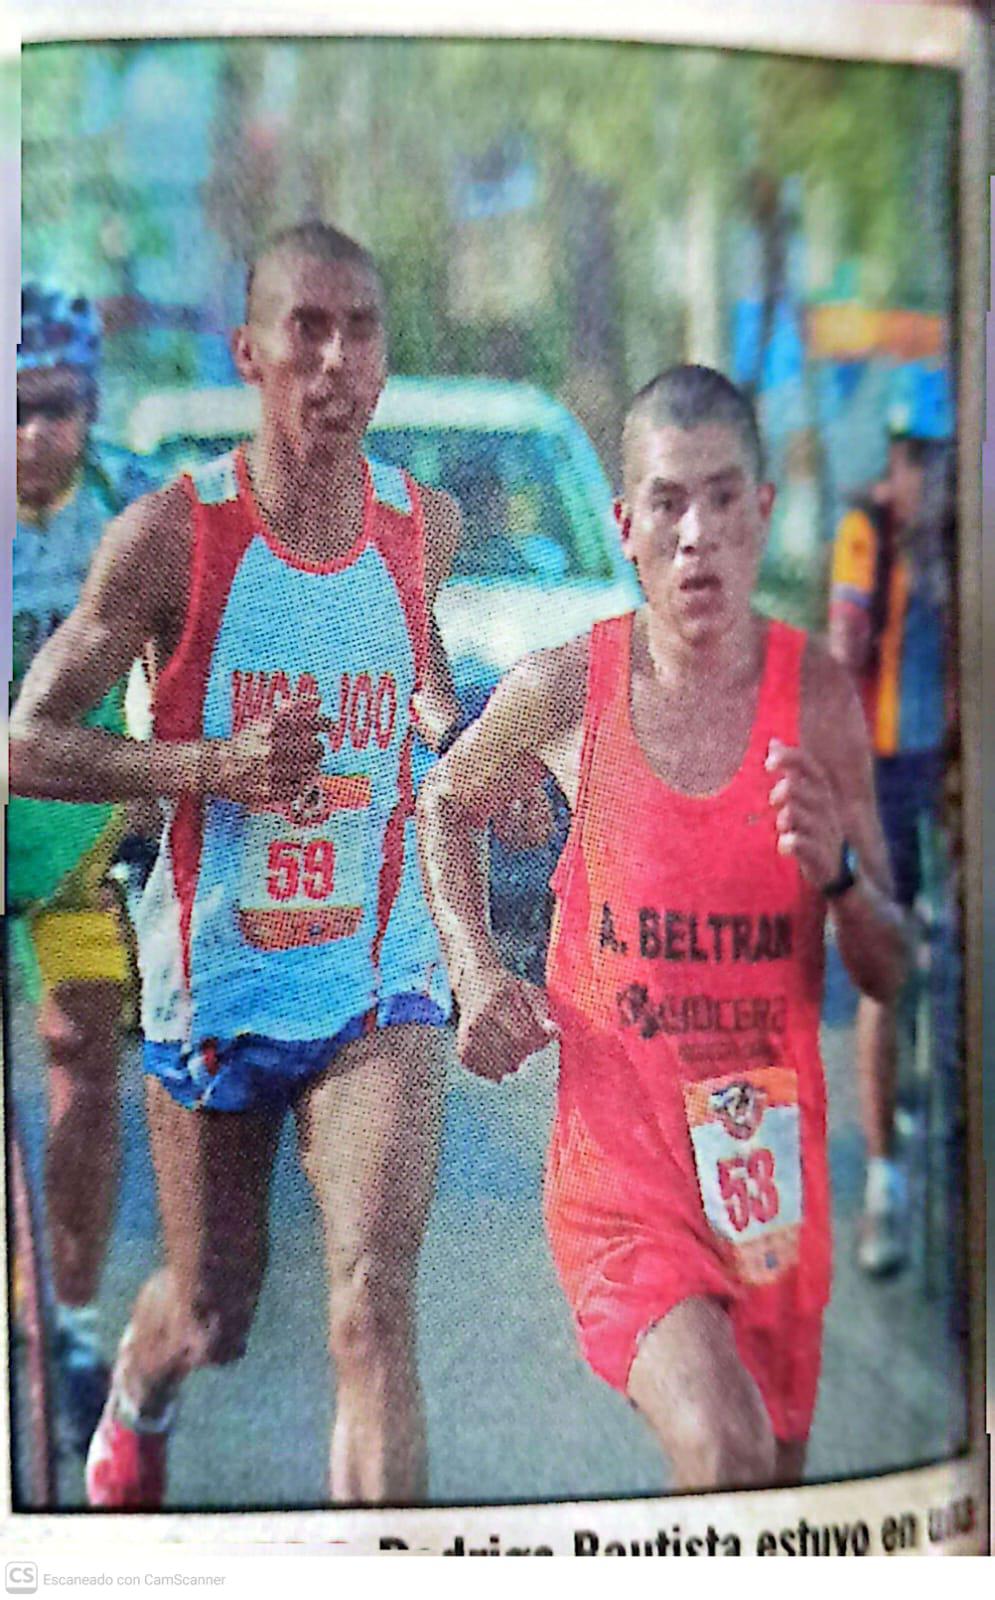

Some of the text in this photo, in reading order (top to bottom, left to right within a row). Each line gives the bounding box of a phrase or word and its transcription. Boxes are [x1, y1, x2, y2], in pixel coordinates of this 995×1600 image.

[266, 838, 336, 901] 59
[599, 900, 793, 963] A. BELTRAN
[717, 1149, 779, 1232] 53
[881, 1510, 919, 1552] en
